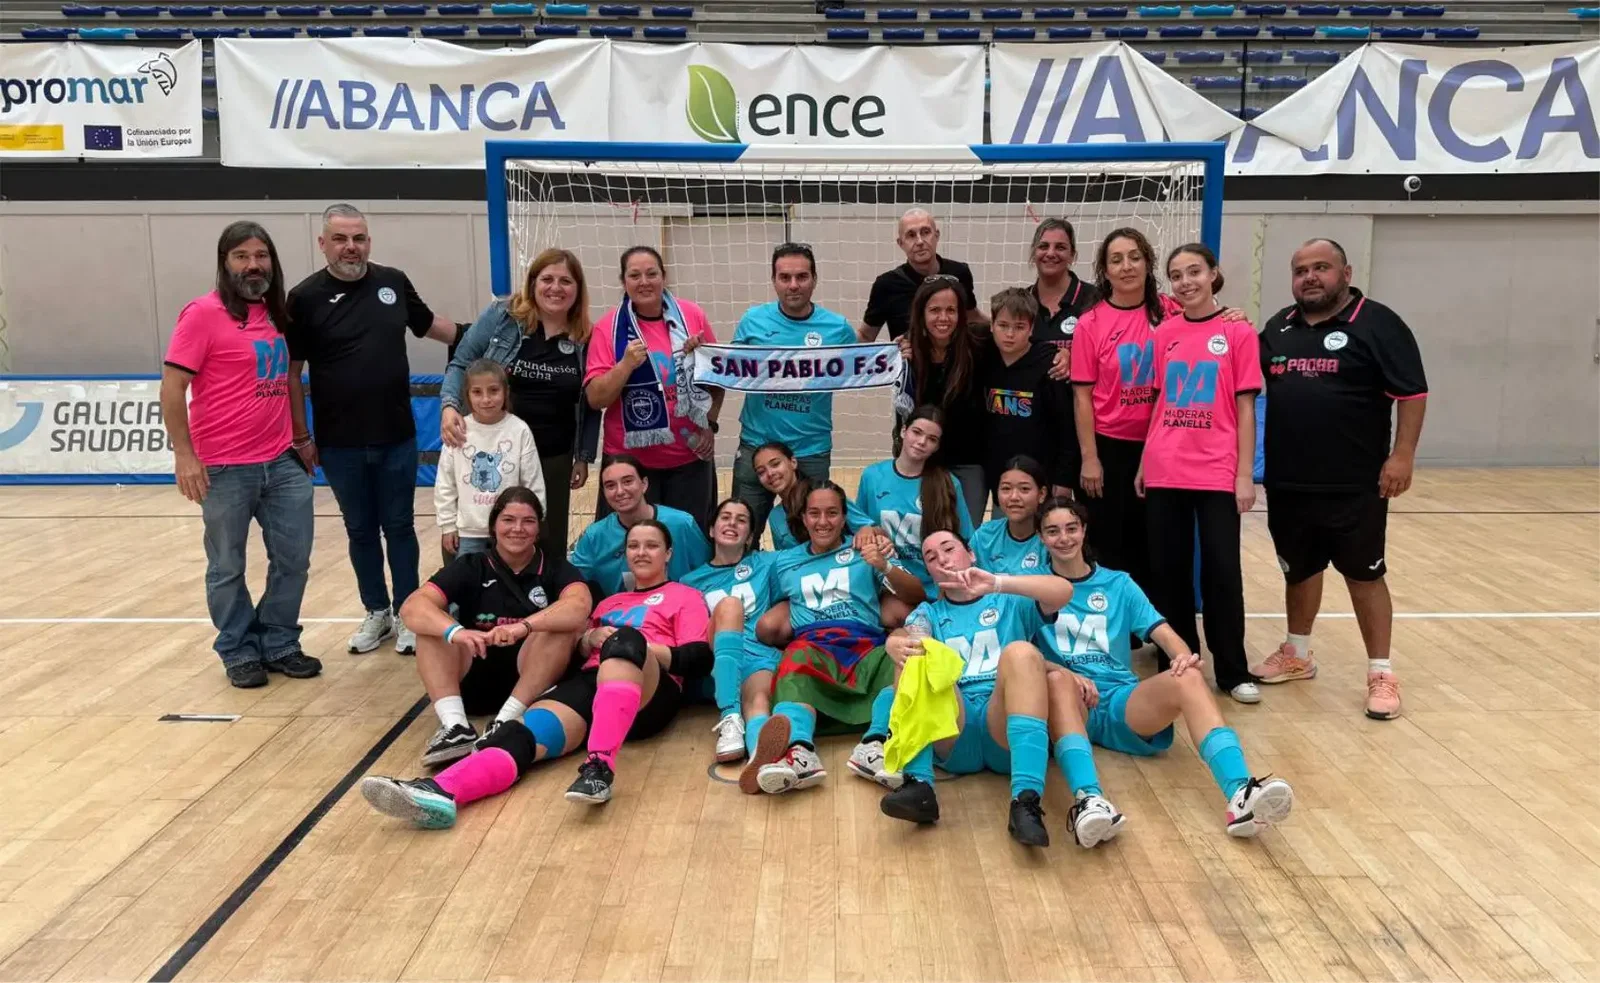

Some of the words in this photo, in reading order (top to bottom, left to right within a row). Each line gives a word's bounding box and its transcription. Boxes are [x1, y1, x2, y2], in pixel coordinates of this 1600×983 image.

[748, 93, 886, 138] ence
[127, 128, 177, 136] Cofinanciado
[179, 128, 191, 136] por
[136, 138, 158, 146] Unión
[160, 138, 192, 146] Europea
[711, 355, 758, 378] SAN
[768, 357, 844, 378] PABLO
[854, 354, 894, 375] F.S.
[513, 366, 551, 381] Pacha
[53, 401, 163, 425] GALICIA
[764, 400, 810, 413] PLANELLS
[1164, 409, 1213, 420] MADERAS
[1163, 419, 1212, 430] PLANELLS
[51, 429, 173, 452] SAUDABL
